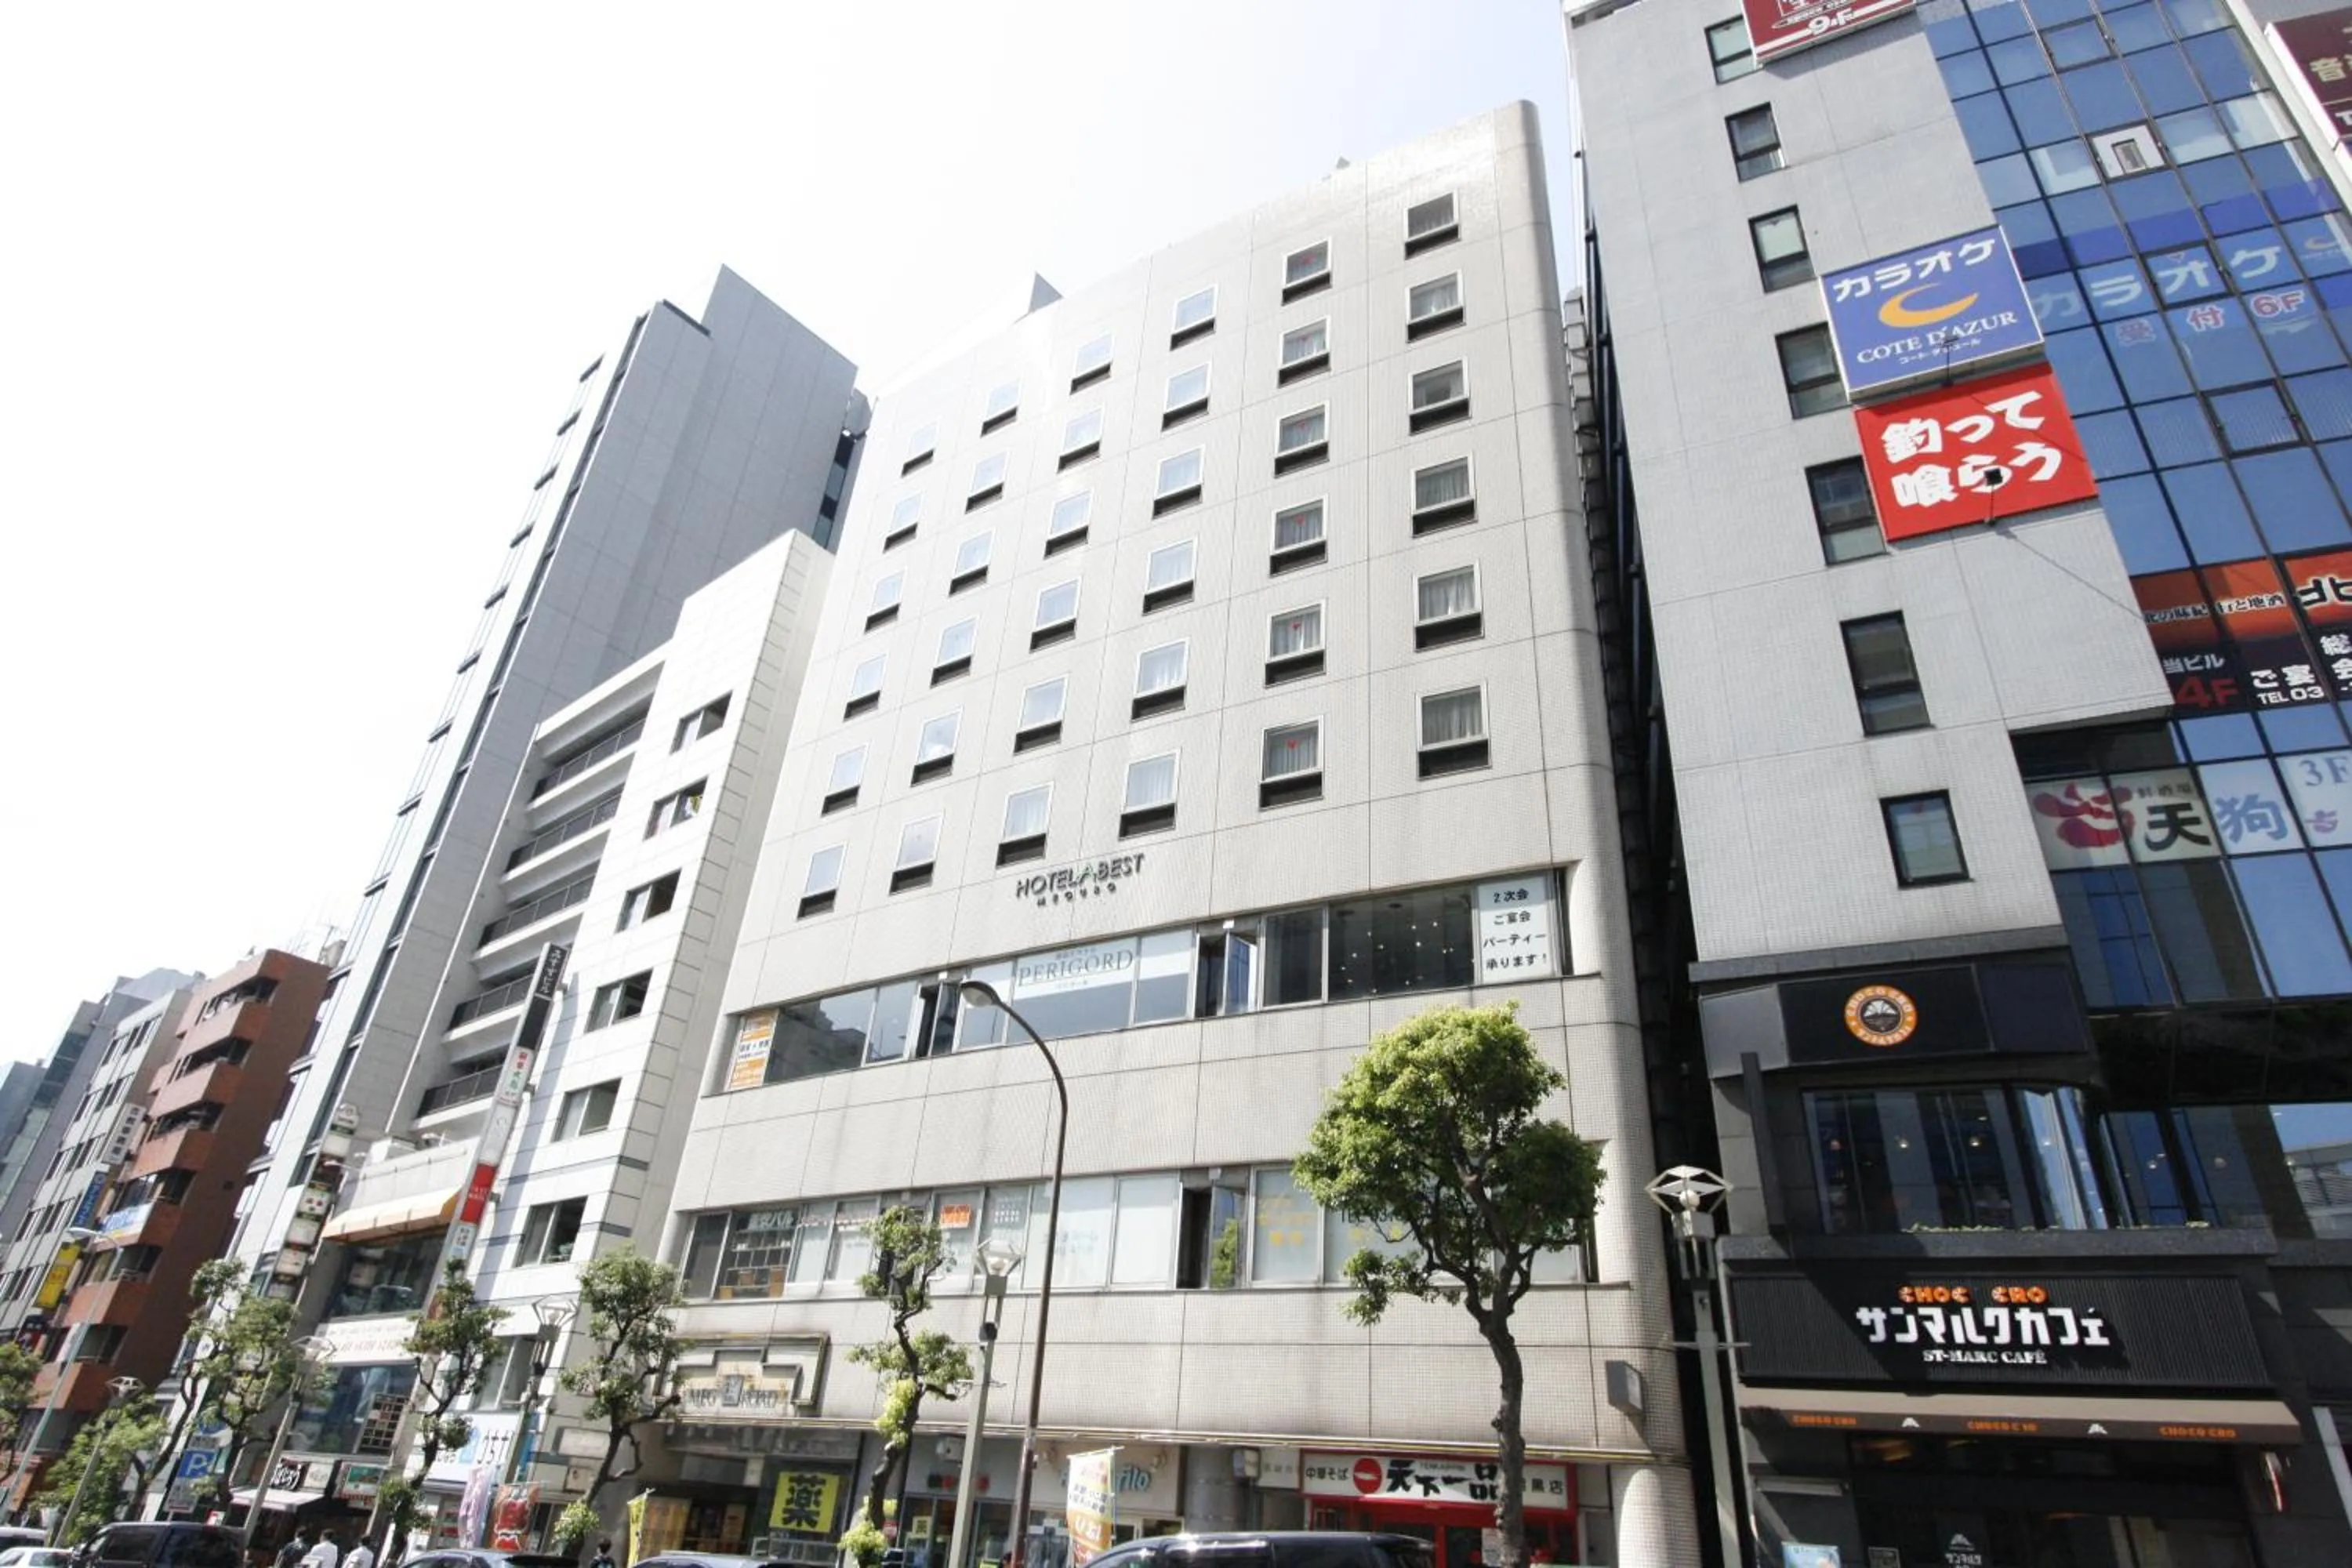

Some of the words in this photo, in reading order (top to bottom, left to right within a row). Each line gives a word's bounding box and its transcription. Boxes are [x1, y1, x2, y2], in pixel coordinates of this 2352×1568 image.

[1832, 239, 1996, 303] カラオケ
[2031, 245, 2281, 318] カラオケ
[2251, 289, 2306, 318] 6F
[1857, 336, 1922, 364] COTE
[1881, 390, 2045, 464] 釣って
[1890, 441, 2063, 508] 喰らう
[2162, 652, 2227, 675] 当ビル
[2174, 675, 2238, 709] 4F
[2256, 691, 2290, 706] TEL
[2143, 793, 2288, 852] 天狗
[1991, 1285, 2049, 1305] CRO
[1856, 1306, 2111, 1347] サンマルクカフェ
[1922, 1349, 1998, 1363] ST-MARC
[1305, 1466, 1349, 1481] 中華そば
[1385, 1459, 1498, 1501] 天下一品
[781, 1475, 826, 1529] 薬
